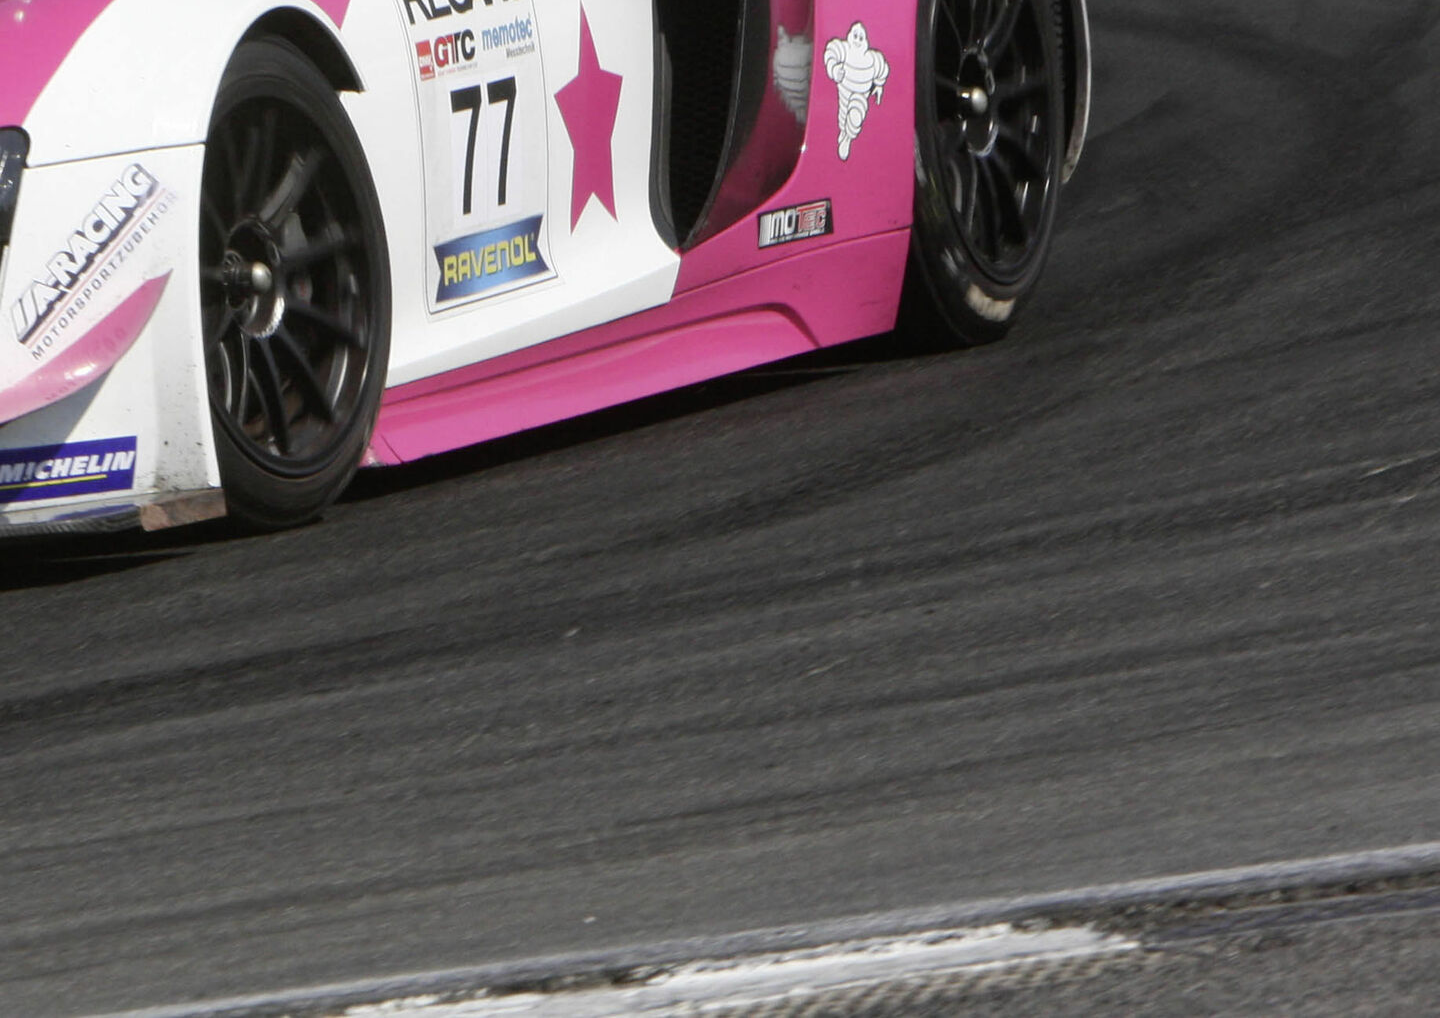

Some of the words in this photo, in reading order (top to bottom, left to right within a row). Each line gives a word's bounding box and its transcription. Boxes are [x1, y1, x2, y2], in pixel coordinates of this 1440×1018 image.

[482, 15, 533, 51] memotec
[450, 76, 517, 215] 77
[443, 234, 537, 286] RAVENOL
